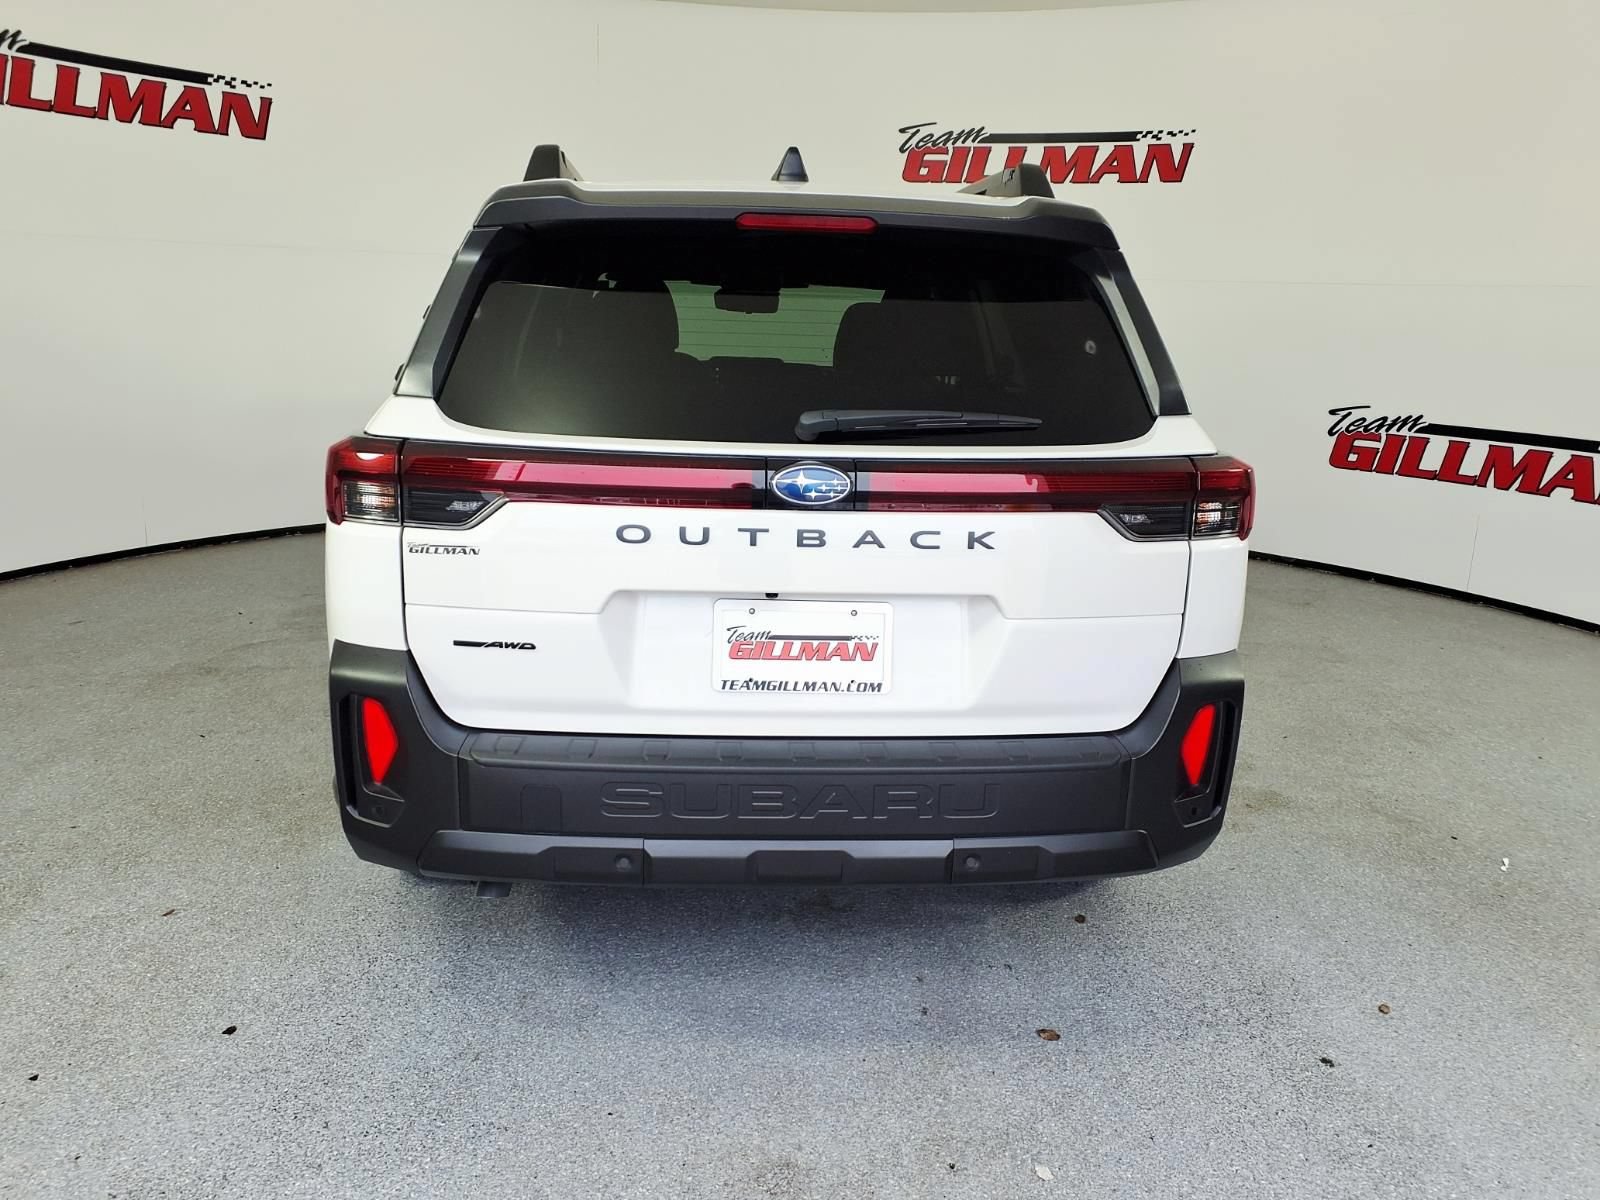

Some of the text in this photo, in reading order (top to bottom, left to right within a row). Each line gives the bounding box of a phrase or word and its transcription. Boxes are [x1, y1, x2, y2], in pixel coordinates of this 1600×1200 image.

[898, 122, 991, 153] Team
[1327, 405, 1427, 437] Team
[1328, 430, 1600, 506] GILLMA
[615, 523, 997, 551] OUTBACK
[408, 546, 480, 556] GILLMAN
[484, 640, 537, 651] AWD
[726, 625, 772, 645] Team
[728, 640, 879, 662] GILLMAN
[720, 679, 883, 693] TEAMGILLMAN.COM
[600, 780, 1001, 820] SUBARU
